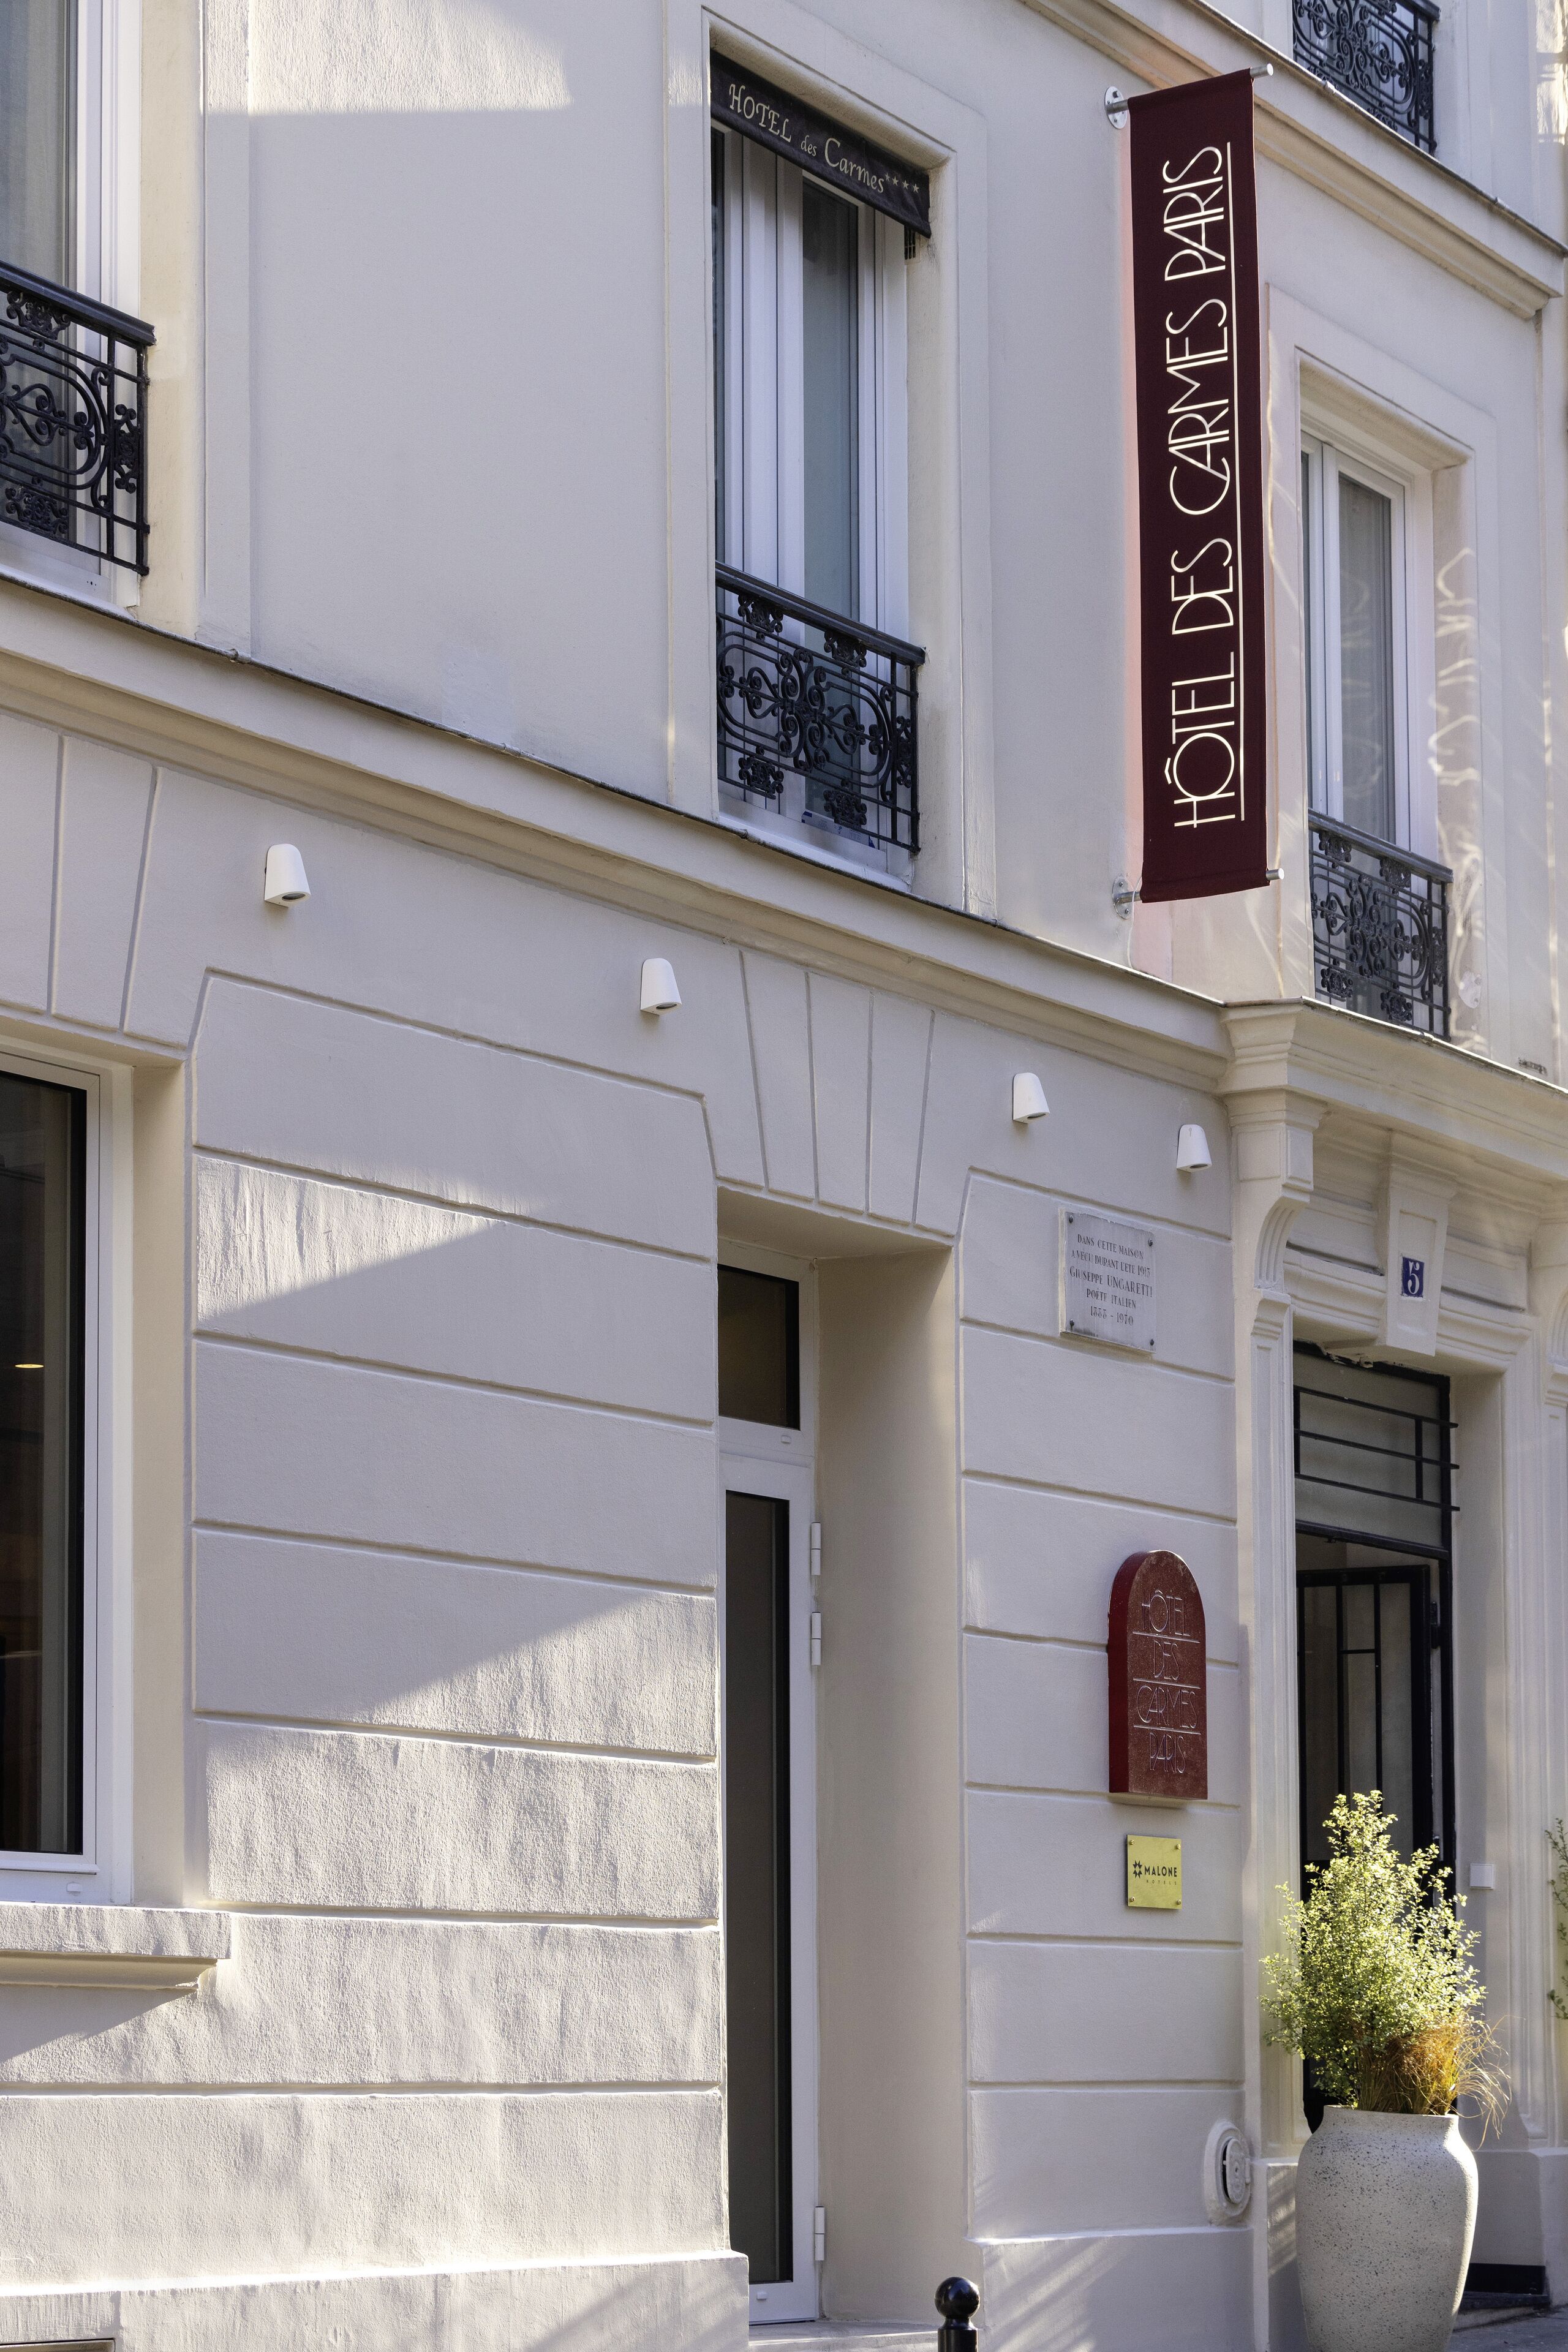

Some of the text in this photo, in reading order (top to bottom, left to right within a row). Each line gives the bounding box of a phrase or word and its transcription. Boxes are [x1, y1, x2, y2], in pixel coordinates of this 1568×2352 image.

[729, 83, 884, 194] HOTEL des Carmes
[1163, 146, 1235, 828] HÔTEL DES CARMES PARIS
[1077, 1234, 1144, 1259] DANS CETTE MAISON
[1095, 1254, 1119, 1270] DURANT
[1069, 1265, 1152, 1297] GIUSEPPE UNGARETTI
[1408, 1261, 1420, 1295] 5
[1111, 1294, 1136, 1309] ITALIEN
[1141, 1589, 1191, 1637] HÔTEL
[1153, 1640, 1180, 1681] DES
[1136, 1686, 1198, 1729] CARMES
[1149, 1732, 1186, 1774] PARIS
[1144, 1865, 1177, 1877] MALONE
